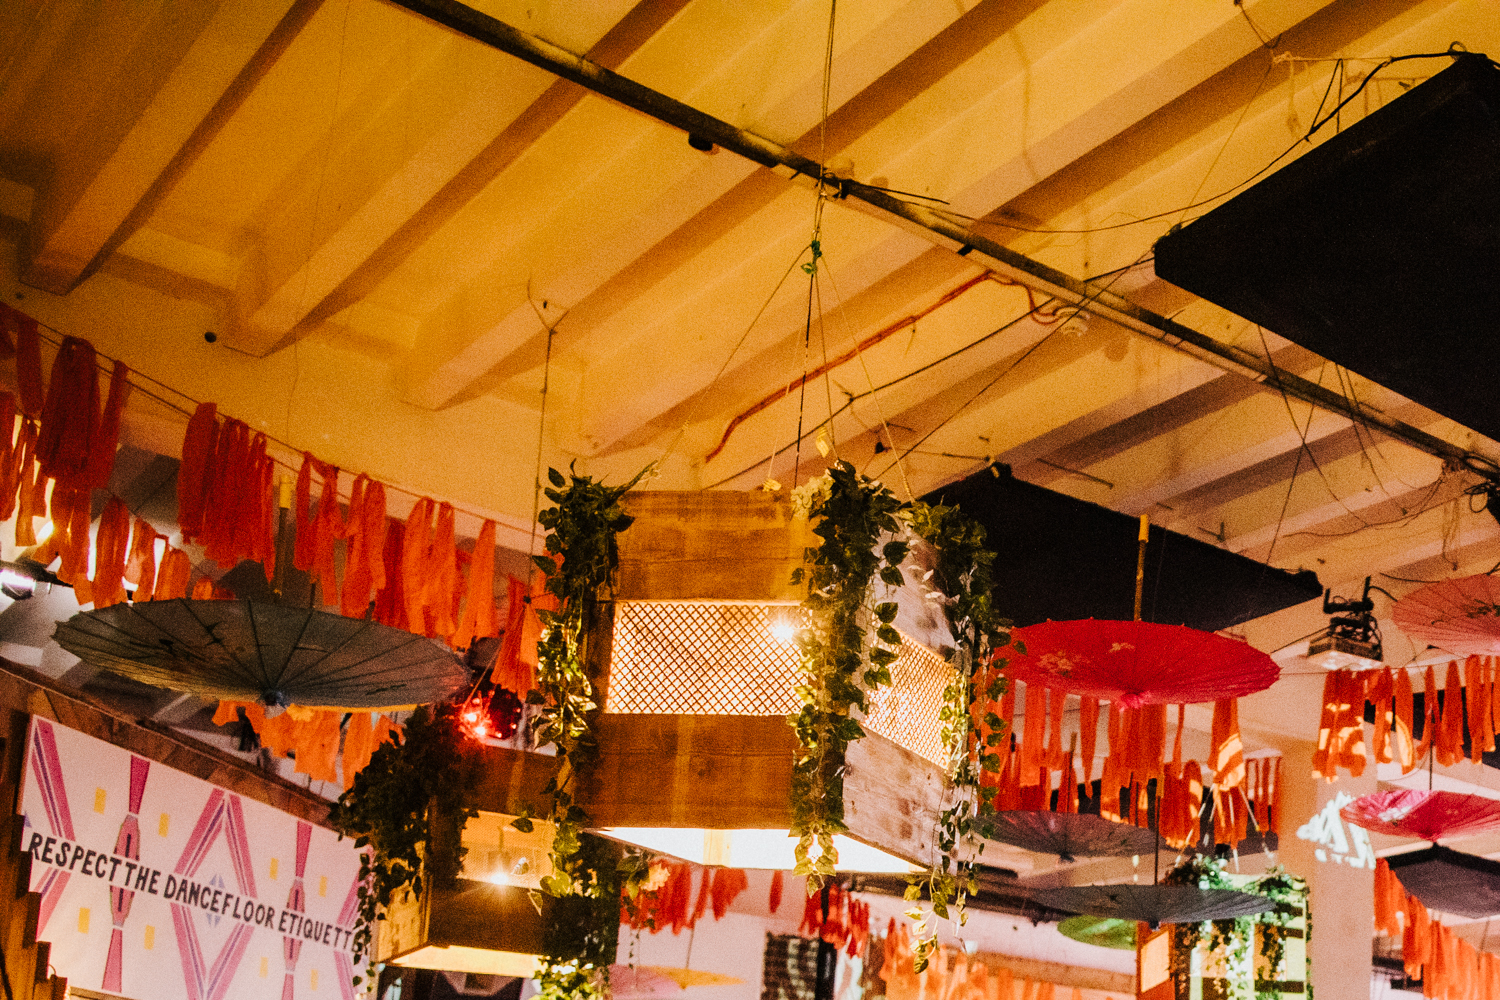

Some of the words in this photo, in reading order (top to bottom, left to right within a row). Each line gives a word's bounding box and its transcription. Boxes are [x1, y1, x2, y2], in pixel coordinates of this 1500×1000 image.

[28, 832, 122, 882] RESPECT
[124, 862, 161, 895] THE
[163, 874, 275, 929] DANCEFLOOR
[278, 911, 361, 955] ETIQUETT
